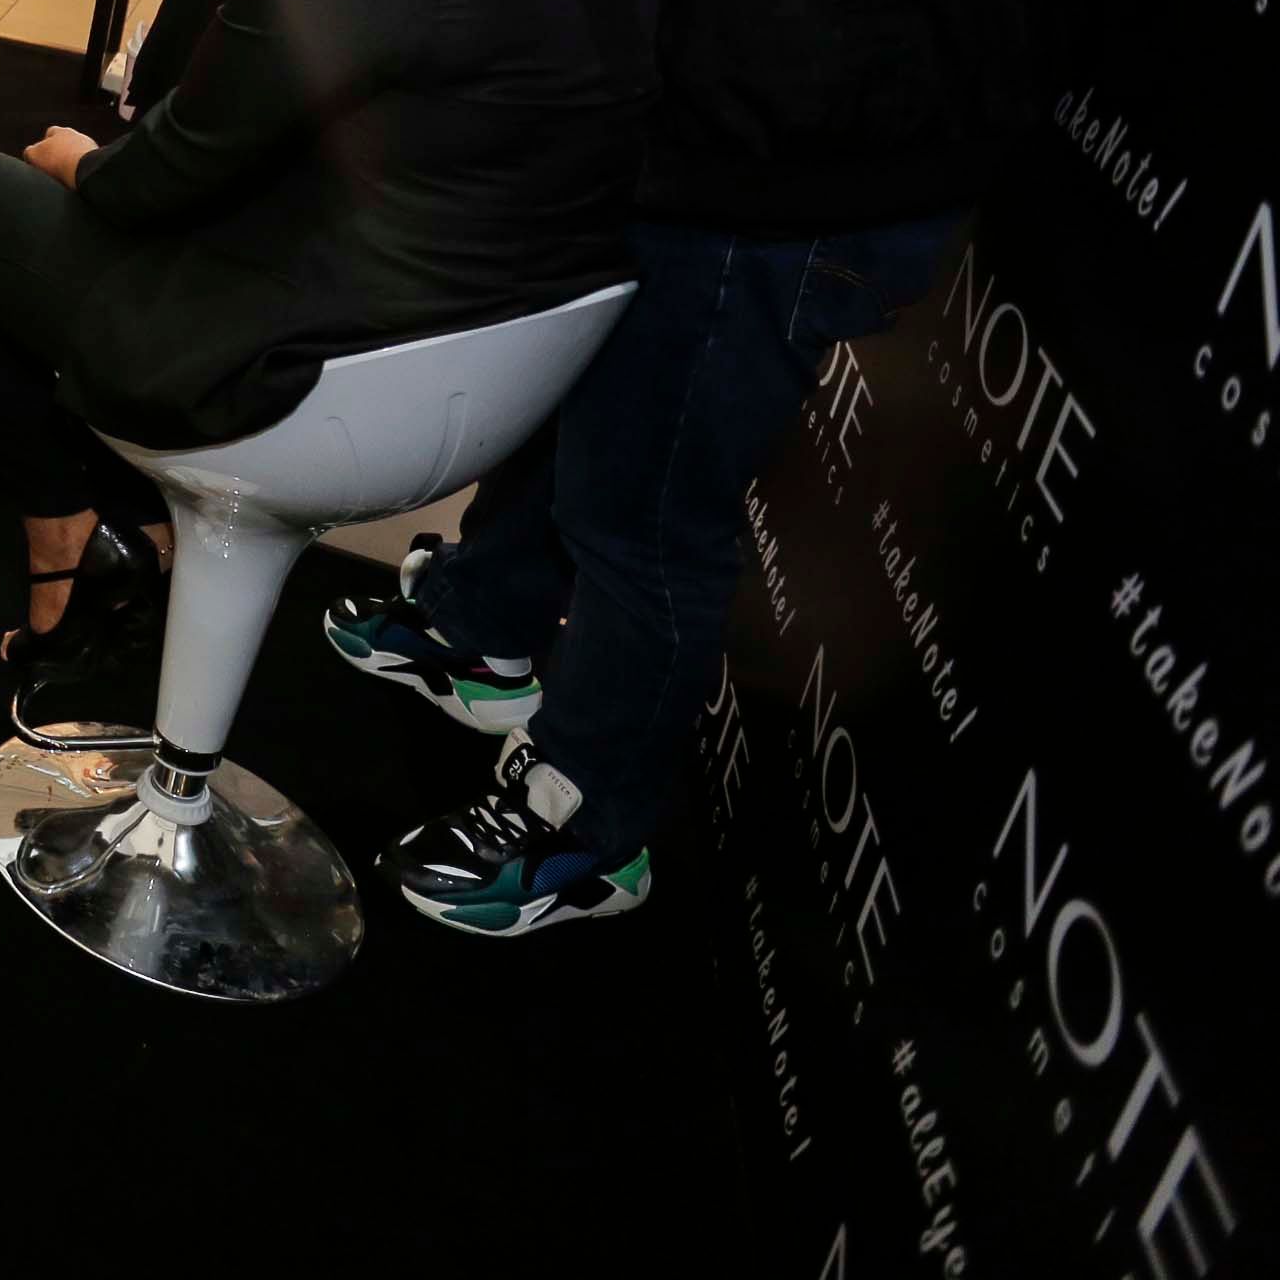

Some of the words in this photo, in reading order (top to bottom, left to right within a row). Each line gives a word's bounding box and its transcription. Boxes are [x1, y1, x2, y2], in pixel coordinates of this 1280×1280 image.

[1053, 83, 1190, 234] akeNote!
[928, 340, 1051, 576] cosmetics
[942, 240, 1098, 525] NOTE
[744, 476, 797, 638] takeNote!
[872, 498, 980, 745] #takeNote!
[798, 642, 902, 986] NOTE
[745, 872, 815, 1164] #takeNote!
[971, 878, 1138, 1280] cosmeti
[991, 764, 1239, 1280] NOTE
